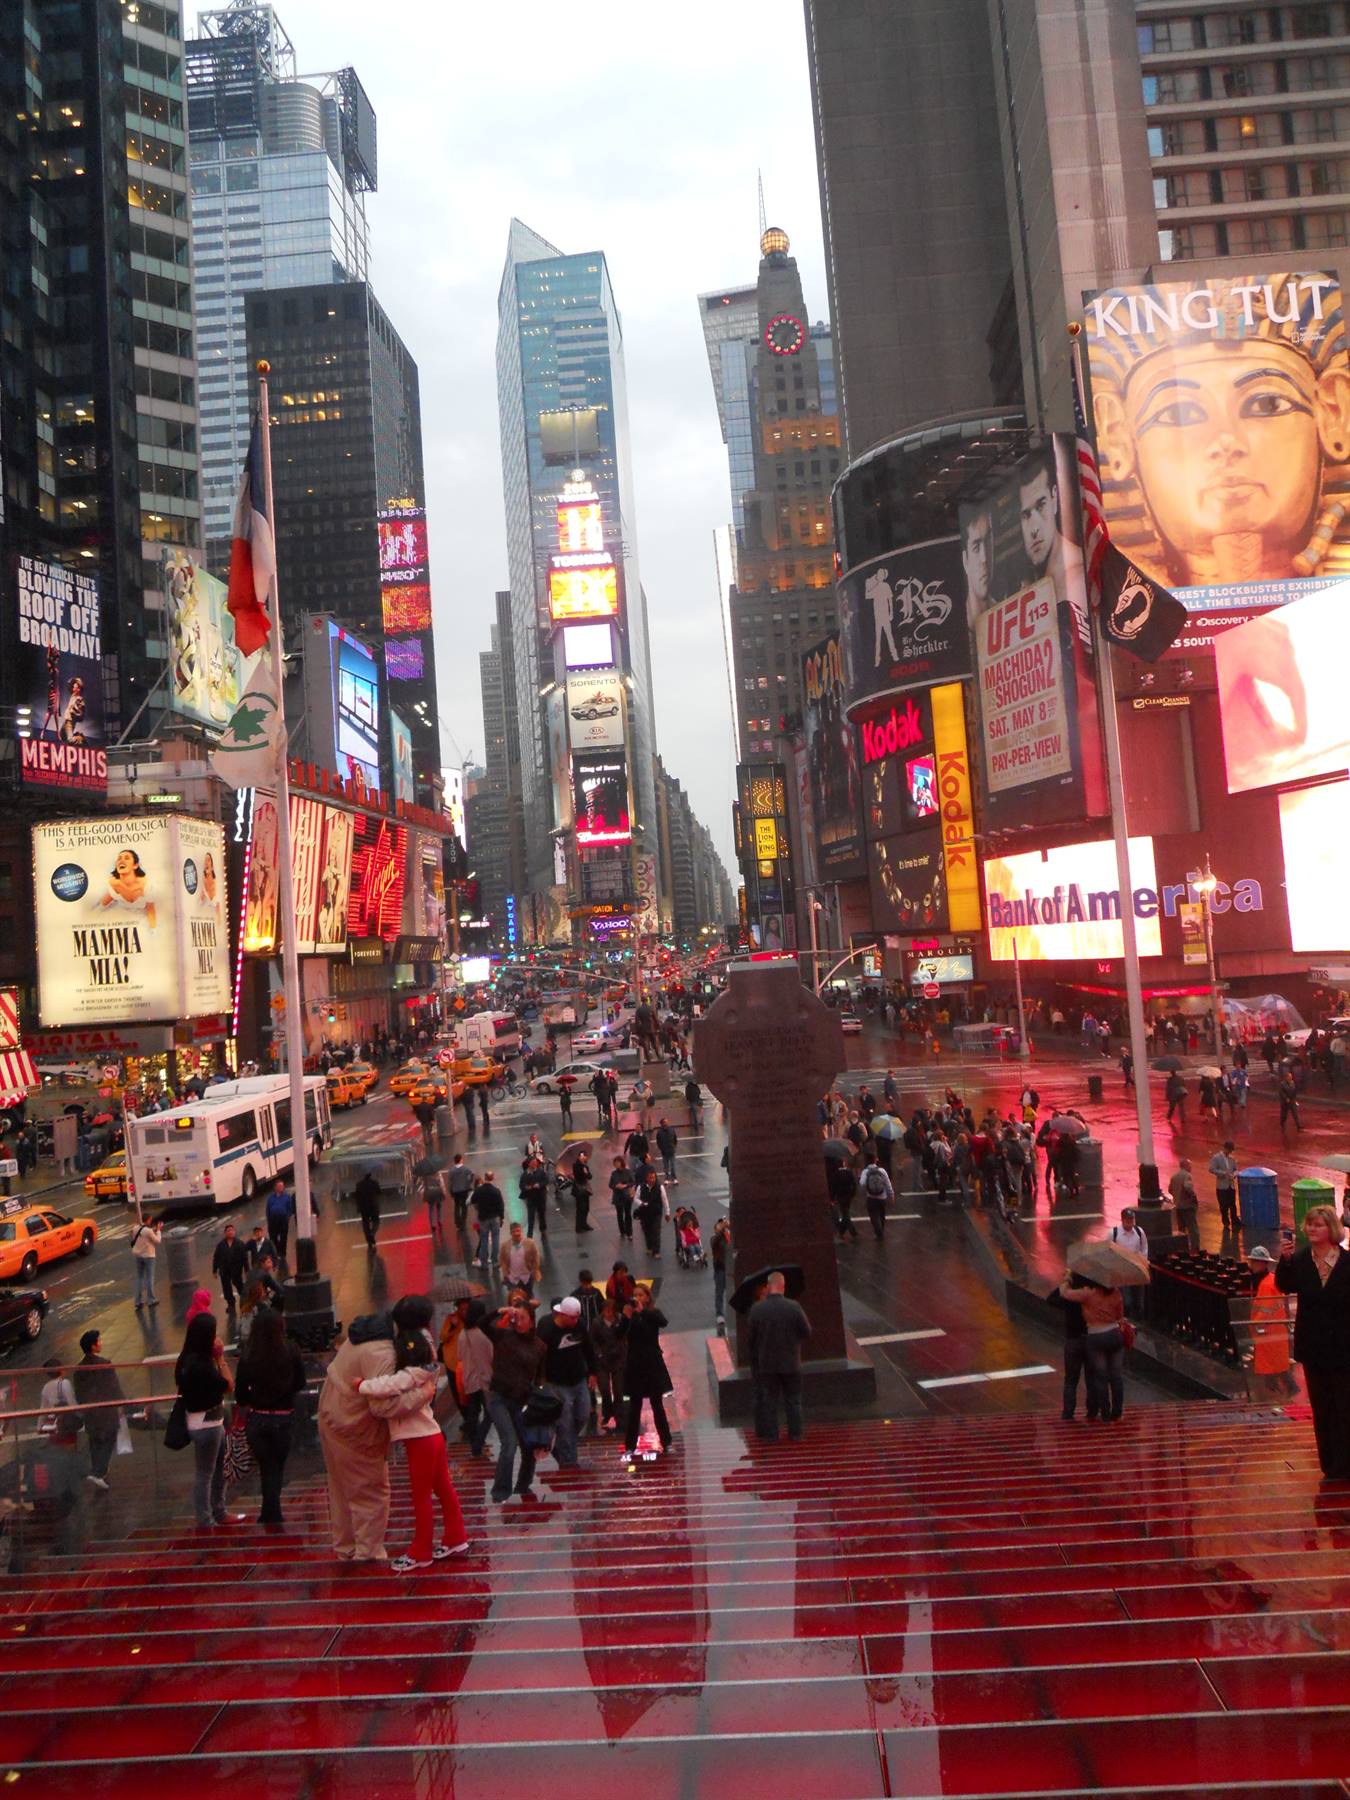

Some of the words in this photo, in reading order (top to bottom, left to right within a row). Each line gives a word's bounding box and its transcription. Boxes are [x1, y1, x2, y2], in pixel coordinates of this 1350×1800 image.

[1092, 290, 1219, 338] KING
[1231, 280, 1332, 326] TUT
[20, 556, 33, 571] THE
[34, 561, 48, 575] NEW
[552, 553, 613, 567] TOSHIBA
[18, 568, 74, 603] BLOWING
[76, 587, 99, 610] THE
[1206, 597, 1231, 607] TIME
[1234, 594, 1284, 606] RETURNS
[1287, 592, 1300, 601] TO
[1209, 583, 1286, 597] BLOCKBUSTER
[20, 588, 65, 626] ROOF
[70, 604, 99, 635] OFF
[987, 591, 1036, 656] UFC
[1028, 602, 1049, 622] 113
[20, 617, 101, 661] BROADWAY!
[903, 641, 949, 658] Sheckler
[984, 643, 1044, 690] MACHIDA
[1043, 638, 1056, 688] 2
[570, 678, 617, 688] SORENTO
[995, 668, 1046, 709] SHOGUN
[862, 699, 924, 762] Kodak
[988, 716, 1010, 740] SAT.
[1011, 705, 1035, 731] MAY
[1039, 701, 1047, 721] 8
[21, 739, 107, 778] MEMPHIS
[991, 734, 1062, 773] PAY-PER-VIEW
[939, 750, 975, 867] Kodak
[67, 821, 122, 837] FEEL-GOOD
[126, 818, 168, 834] MUSICAL
[759, 835, 774, 843] LION
[55, 839, 64, 849] IS
[68, 838, 76, 847] A
[759, 845, 775, 854] KING
[988, 885, 1043, 928] Bank
[1042, 885, 1066, 925] of
[1067, 872, 1264, 924] America
[73, 926, 142, 957] MAMMA
[190, 921, 217, 948] MAMMA
[197, 949, 214, 974] MIA!
[907, 947, 973, 958] MARQUIS
[89, 956, 130, 986] MIA!
